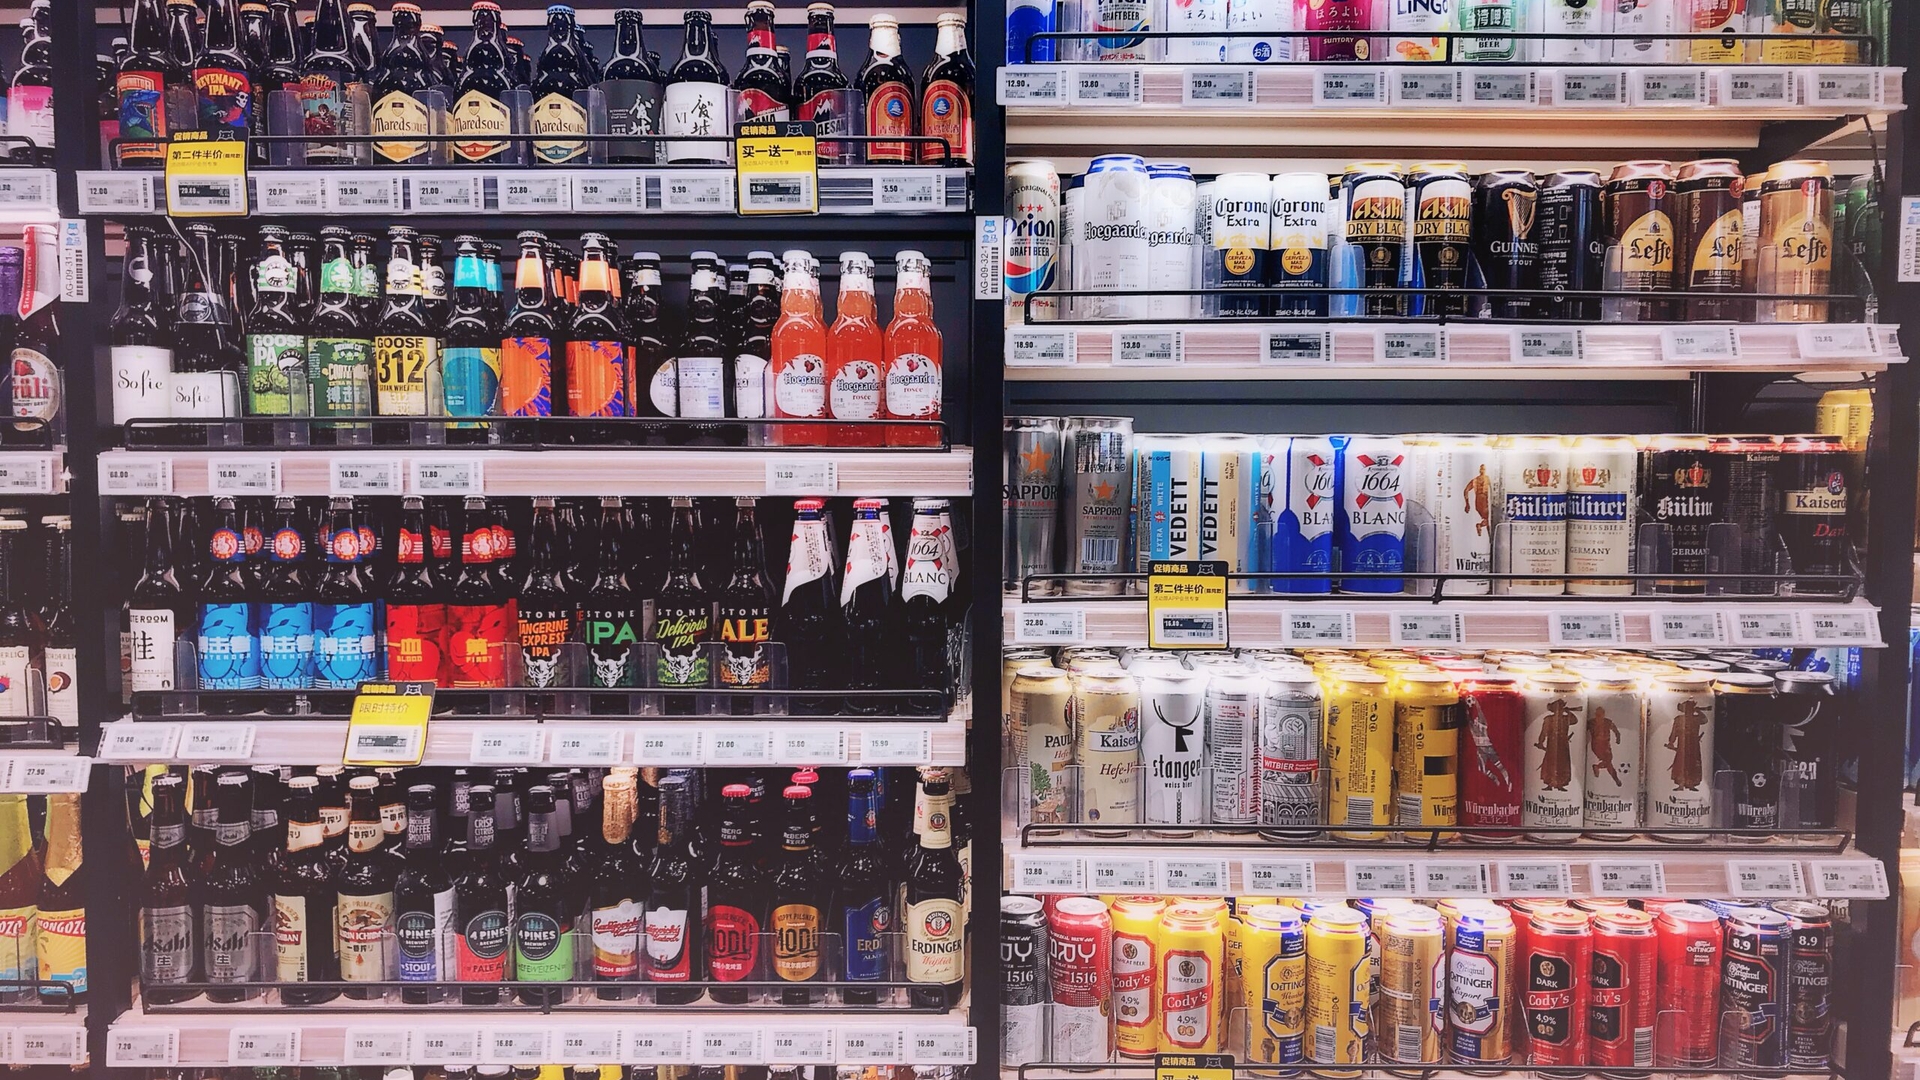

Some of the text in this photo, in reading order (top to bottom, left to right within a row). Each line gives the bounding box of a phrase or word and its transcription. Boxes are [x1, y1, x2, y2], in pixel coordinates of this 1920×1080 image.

[1102, 12, 1140, 23] DRAFT BEER
[1315, 5, 1363, 20] ほろよい
[1465, 8, 1513, 28] 台湾啤酒
[1323, 36, 1354, 45] SUNTORY
[1478, 41, 1500, 49] BEER
[209, 85, 226, 96] IPA
[374, 116, 428, 133] Maredsous
[675, 112, 688, 125] VI
[172, 149, 223, 160] 第二件半价
[742, 144, 794, 159] 买一送一
[1215, 197, 1268, 217] Corona
[1272, 197, 1325, 217] Corona
[1224, 214, 1260, 227] Extra
[1280, 214, 1317, 227] Extra
[1348, 221, 1371, 235] DRY
[1415, 221, 1440, 235] DRY
[1010, 246, 1050, 257] DRAFT BEER
[1628, 237, 1672, 266] Leffe
[1781, 236, 1828, 265] Leffe
[66, 247, 74, 298] AG-09-31-1
[980, 245, 989, 296] AG-09-32-1
[252, 334, 304, 347] GOOSE
[377, 337, 424, 349] GOOSE
[253, 346, 277, 366] IPA
[378, 349, 425, 383] 312
[117, 368, 164, 397] Sofie
[175, 385, 210, 410] Sofie
[1361, 473, 1401, 491] 1664
[1082, 505, 1122, 516] SAPPORO
[1156, 481, 1165, 552] EXTRA WHITE
[1170, 477, 1188, 557] VEDETT
[1202, 477, 1219, 556] VEDETT
[910, 541, 939, 557] 1664
[1569, 547, 1611, 556] GERMANY
[1153, 564, 1188, 574] 促销商品
[903, 571, 946, 585] BLANC
[1153, 583, 1204, 594] 第二件半价
[518, 610, 567, 618] STONE
[586, 610, 635, 618] STONE
[657, 607, 706, 617] STONE
[721, 607, 768, 616] STONE
[517, 618, 570, 637] TANGERINE
[585, 620, 638, 645] IPA
[656, 614, 709, 639] Delicious
[720, 618, 769, 642] ALE
[522, 632, 566, 646] EXPRESS
[671, 634, 695, 649] IPA
[531, 646, 550, 657] IPA
[1264, 759, 1294, 771] WITBIER
[1182, 780, 1193, 788] bier
[1465, 801, 1521, 818] Würenbacher
[1525, 800, 1581, 818] Würenbacher
[1655, 800, 1711, 817] Würenbacher
[409, 825, 431, 833] COFFEE
[474, 817, 493, 828] CRISP
[409, 833, 431, 842] SMOOTH
[474, 828, 494, 836] CITRUS
[474, 835, 494, 843] HOPPY
[470, 930, 478, 940] 4
[524, 931, 556, 941] PINES
[1798, 935, 1818, 947] 8.9
[912, 938, 962, 954] ERDINGER
[1732, 938, 1751, 951] 8.9
[404, 962, 431, 972] STOUT
[473, 963, 494, 973] PALE
[654, 971, 685, 980] BREWED
[1007, 970, 1034, 983] 1516
[1070, 971, 1098, 984] 1516
[1114, 973, 1151, 990] Cody's
[1191, 976, 1204, 984] BEER
[1536, 978, 1558, 988] DARK
[1121, 994, 1140, 1006] 4.9%
[1166, 991, 1208, 1009] Cody's
[1528, 993, 1570, 1009] Cody's
[1177, 1015, 1198, 1025] 4.9%
[1535, 1015, 1557, 1025] 4.9%
[1161, 1056, 1196, 1066] 促销商品
